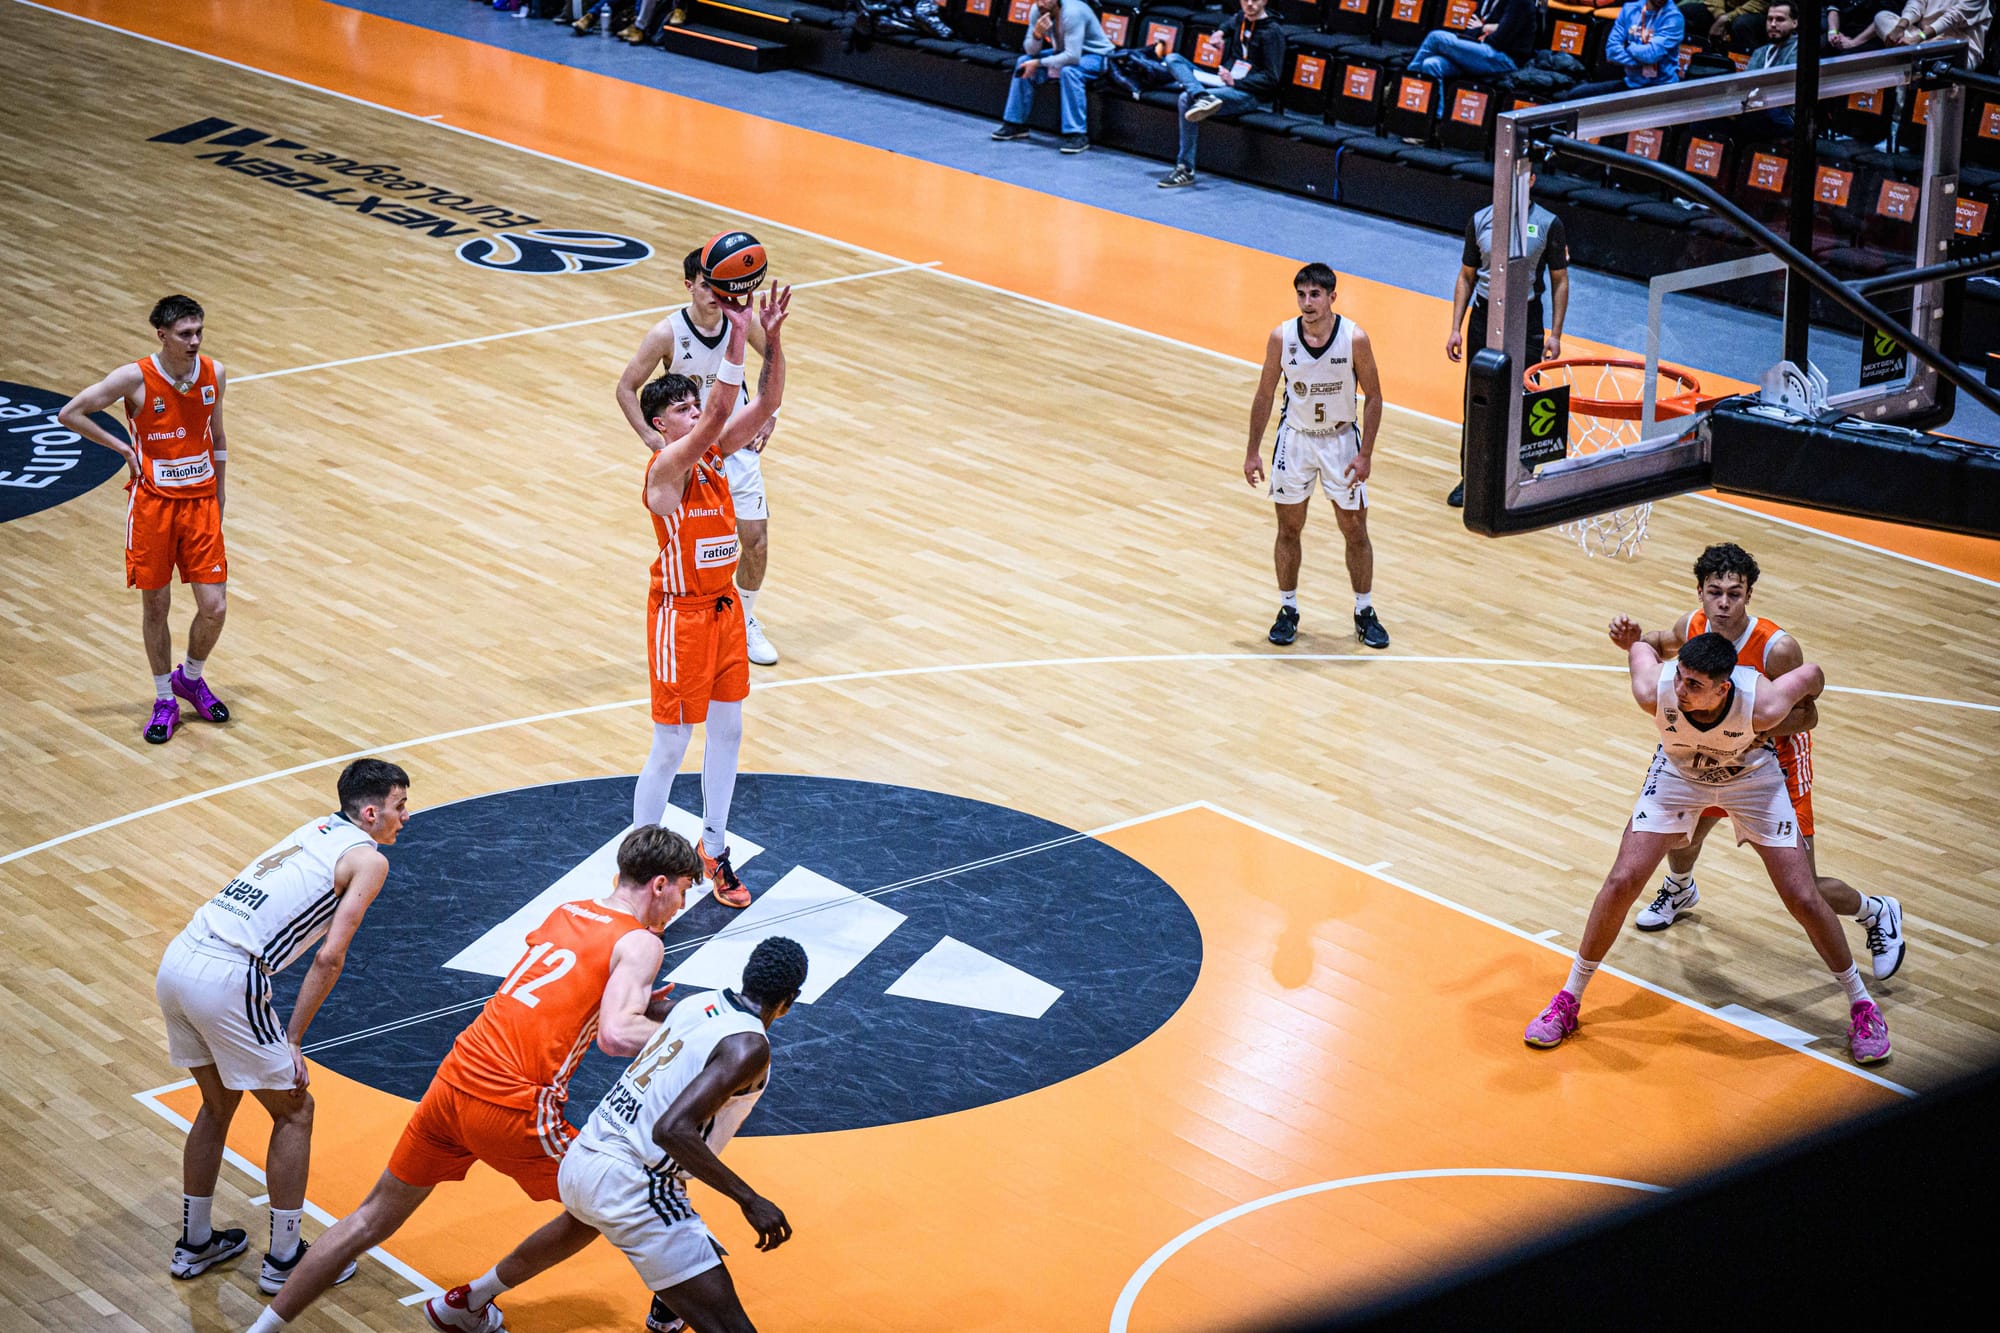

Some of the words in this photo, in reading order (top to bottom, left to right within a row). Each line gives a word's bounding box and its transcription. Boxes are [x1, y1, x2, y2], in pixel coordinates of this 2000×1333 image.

[195, 150, 480, 238] NEXTGEN
[294, 151, 542, 229] EuroLeague
[1314, 403, 1326, 423] 5
[148, 431, 175, 440] Allianz
[688, 507, 718, 518] Allianz
[1776, 821, 1792, 835] 15
[253, 844, 304, 880] 4
[500, 941, 577, 1009] 12
[625, 1027, 684, 1094] 12
